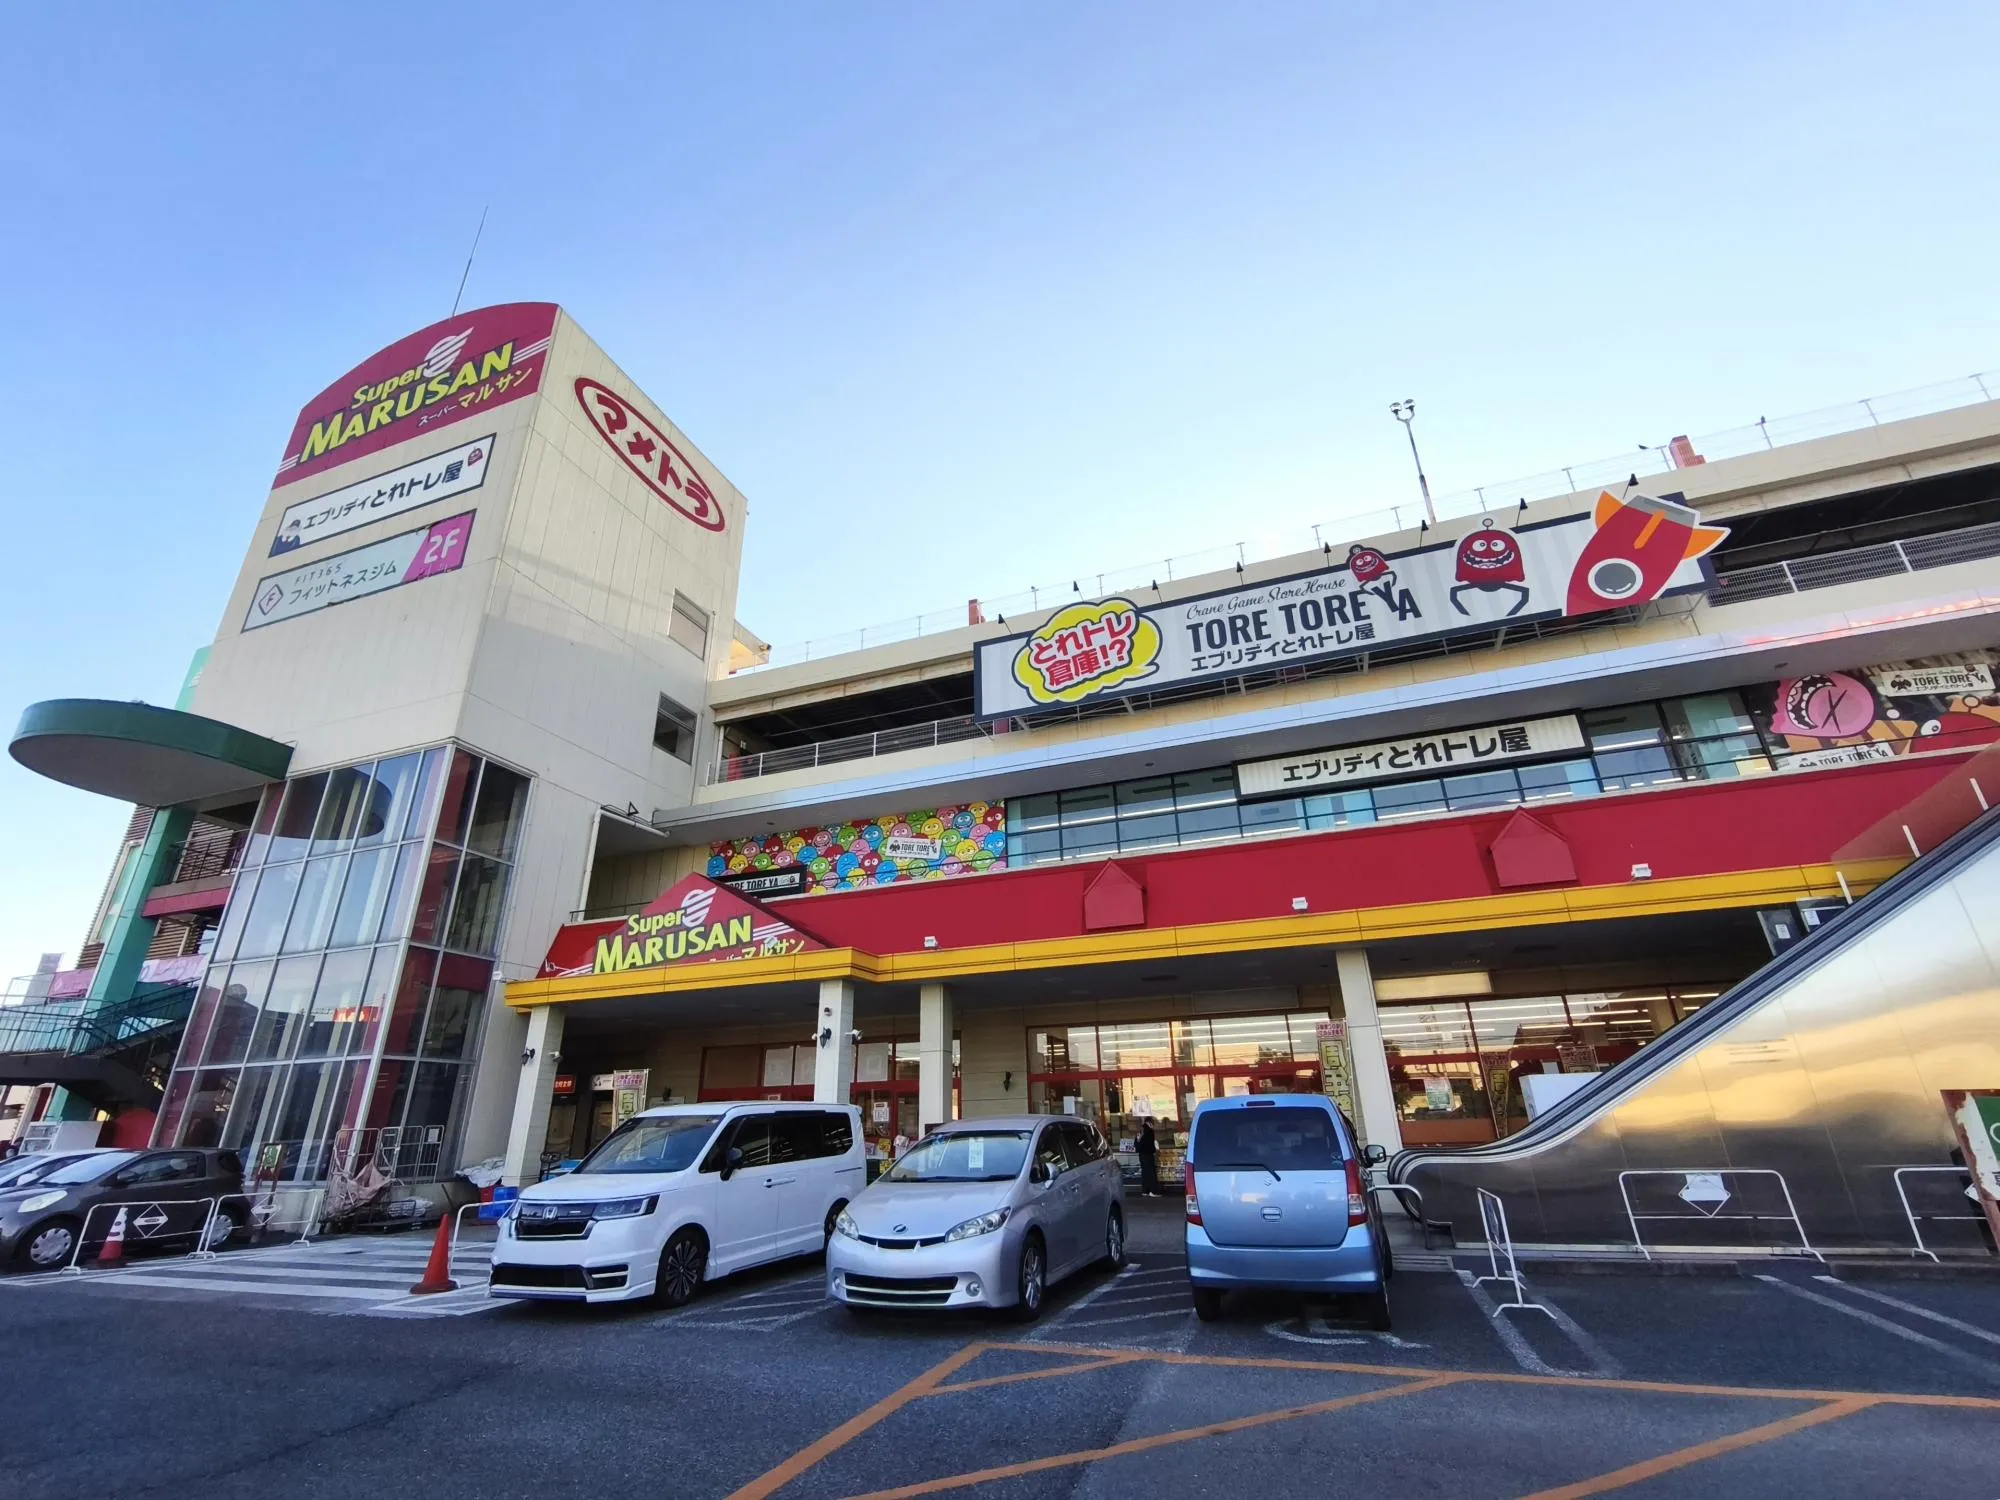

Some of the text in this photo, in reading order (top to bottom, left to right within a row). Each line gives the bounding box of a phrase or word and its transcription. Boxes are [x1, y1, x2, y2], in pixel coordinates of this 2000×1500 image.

[301, 342, 513, 462] MARUSAN
[351, 362, 428, 409] Super
[418, 367, 532, 427] スーパー マルサン
[424, 528, 461, 565] 2F
[288, 560, 397, 605] フィットネスジム
[1186, 609, 1272, 653] TORE
[1279, 591, 1371, 634] TORE
[1187, 603, 1224, 620] Crane
[1228, 595, 1265, 613] Game
[1033, 615, 1132, 665] とれトレ
[594, 916, 752, 974] MARUSAN
[627, 910, 685, 936] Super
